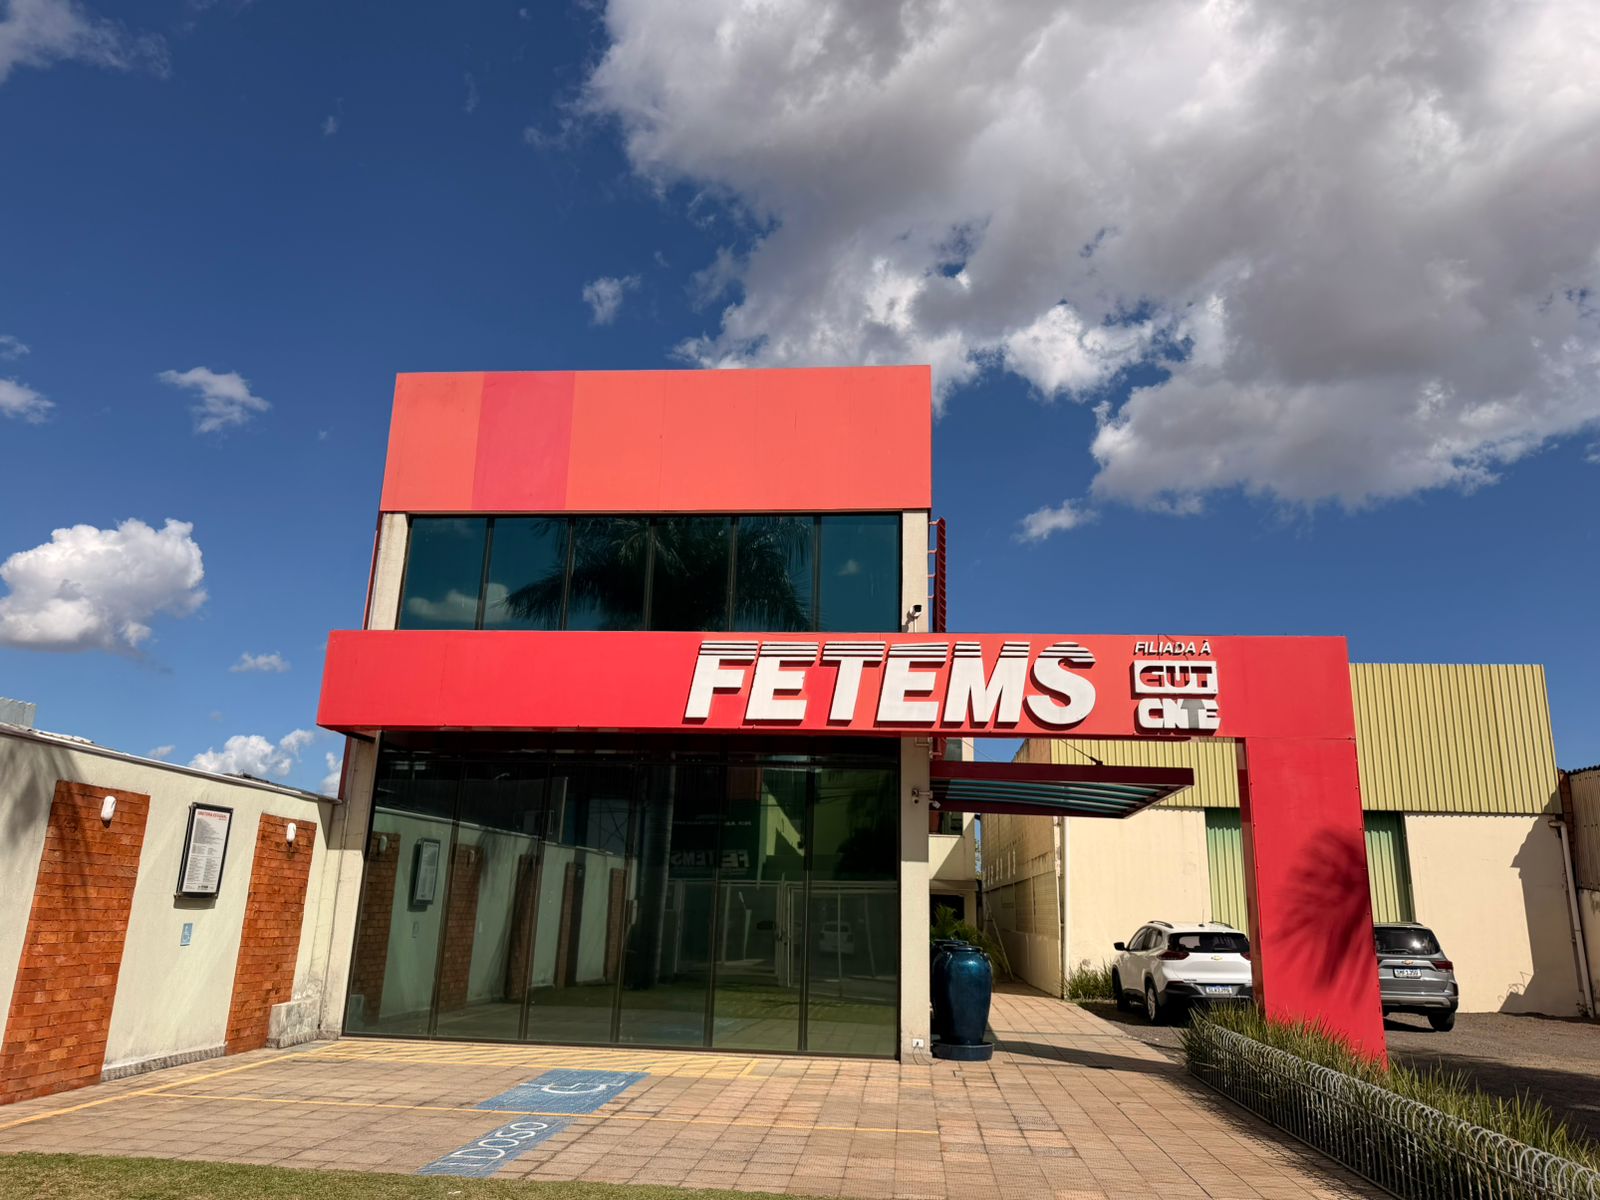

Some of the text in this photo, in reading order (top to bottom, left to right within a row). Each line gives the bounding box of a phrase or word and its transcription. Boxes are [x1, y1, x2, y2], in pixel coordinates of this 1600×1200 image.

[1134, 641, 1196, 655] FILIADA
[684, 640, 1096, 725] FETEMS
[1138, 698, 1221, 729] CNTE
[431, 1121, 549, 1168] IDOSO
